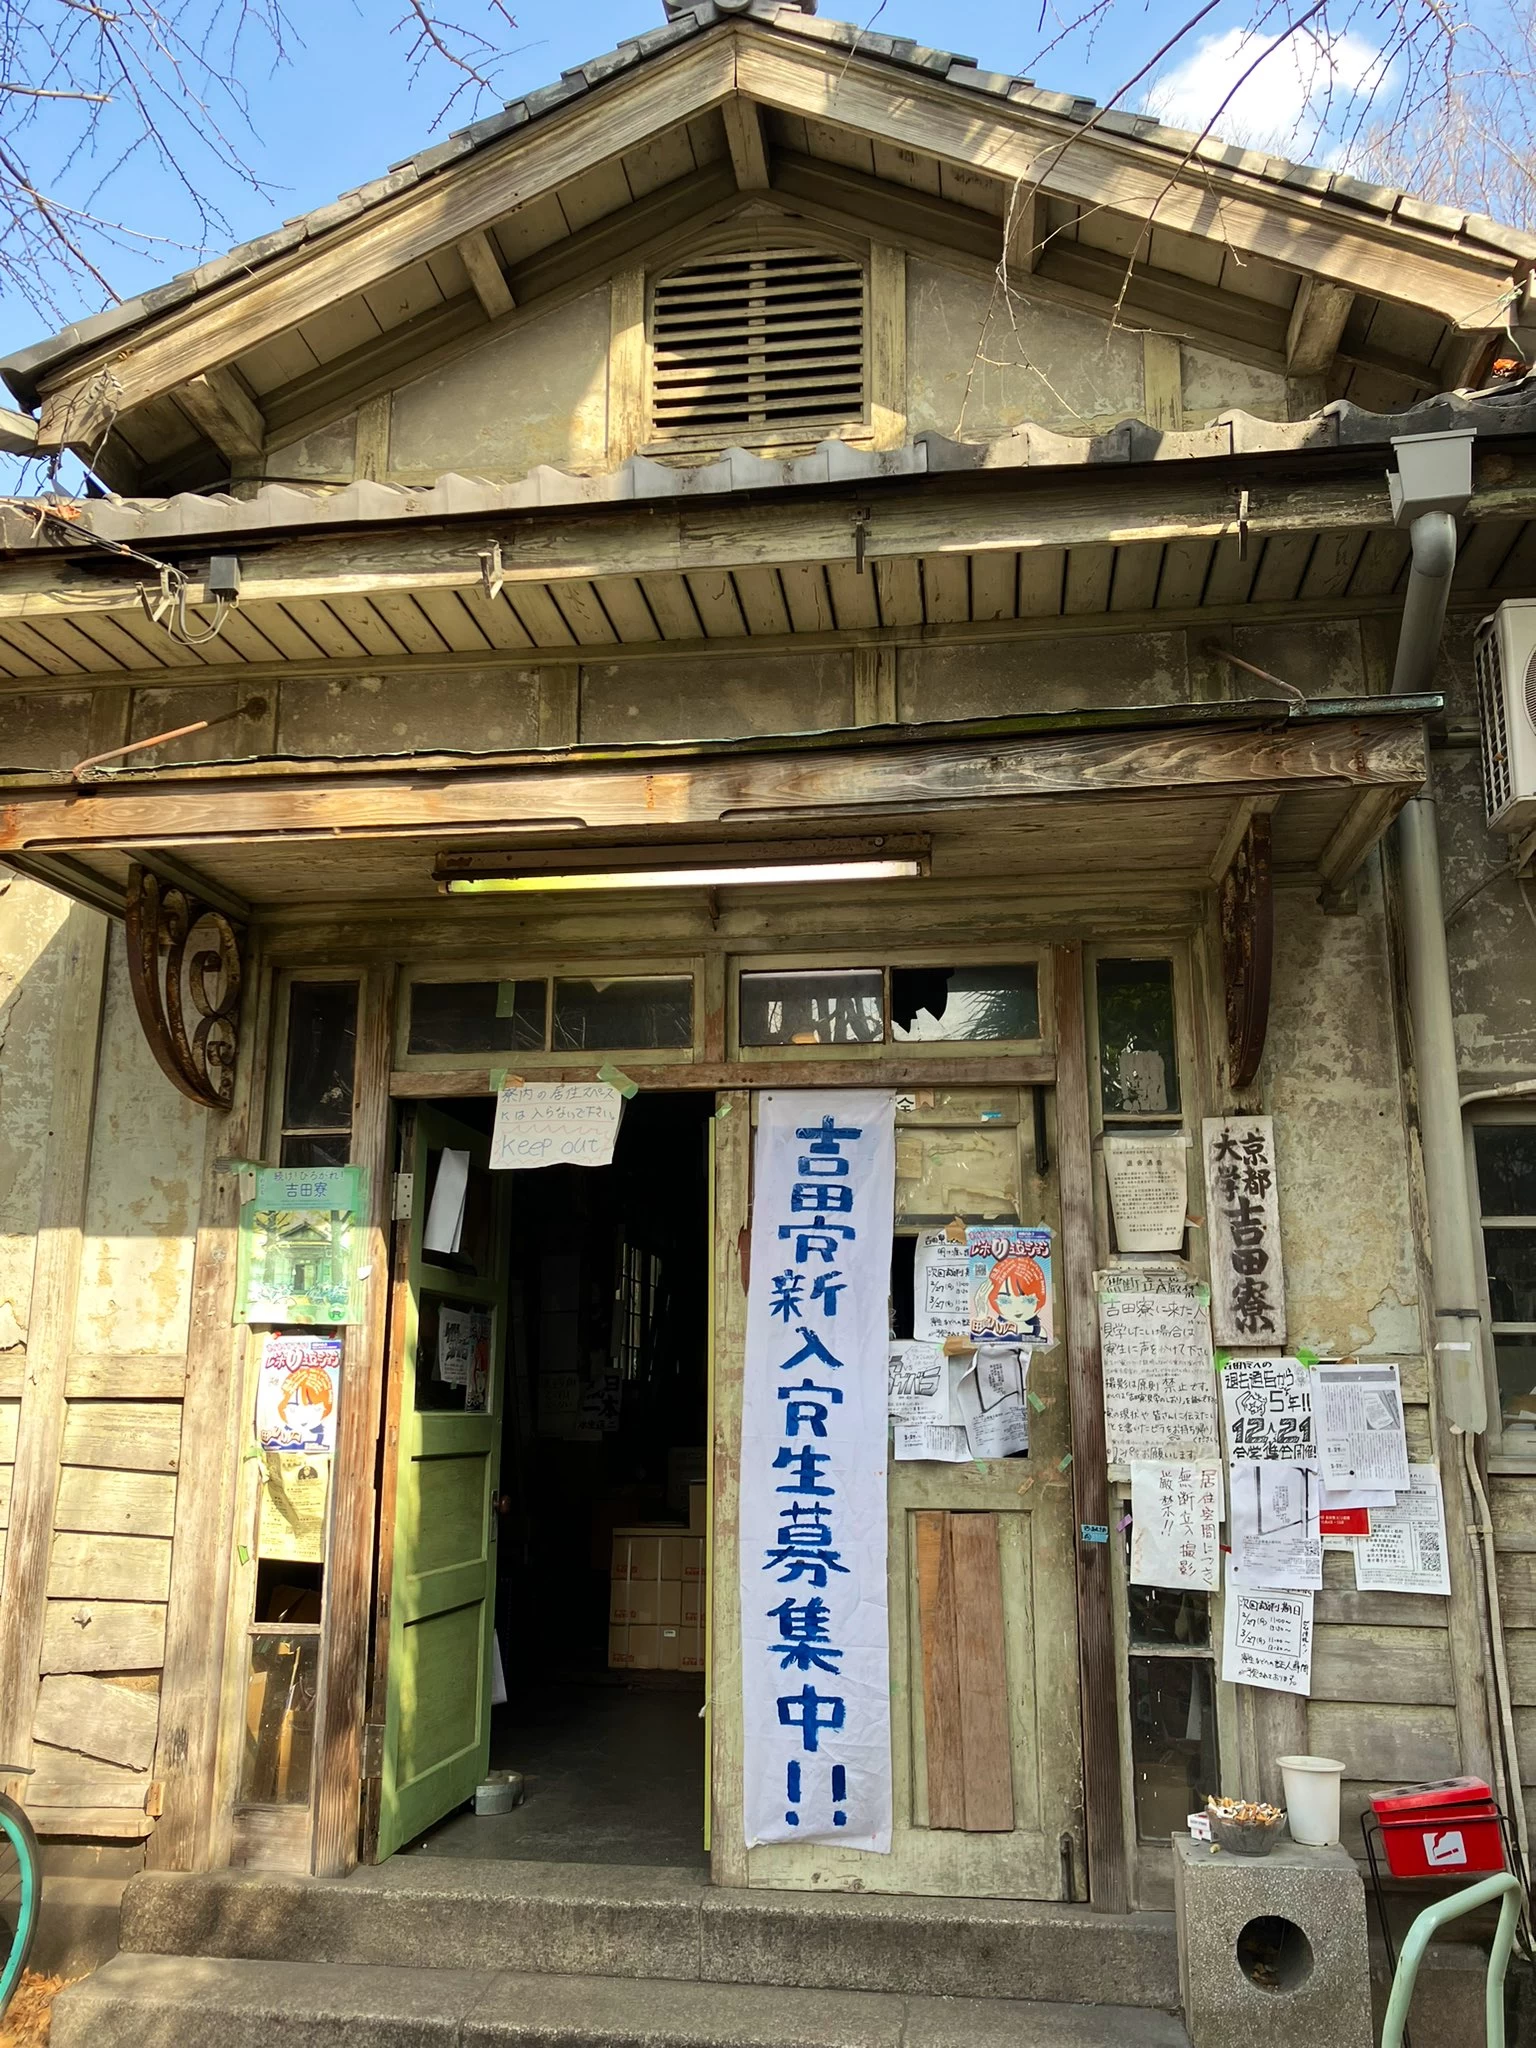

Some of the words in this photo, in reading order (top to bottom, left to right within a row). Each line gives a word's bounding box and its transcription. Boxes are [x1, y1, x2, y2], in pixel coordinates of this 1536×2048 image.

[561, 1138, 599, 1155] out
[1213, 1133, 1243, 1202] 大学
[1239, 1132, 1272, 1200] 京都
[285, 1182, 328, 1198] 吉田寮
[1224, 1195, 1276, 1335] 吉田寮
